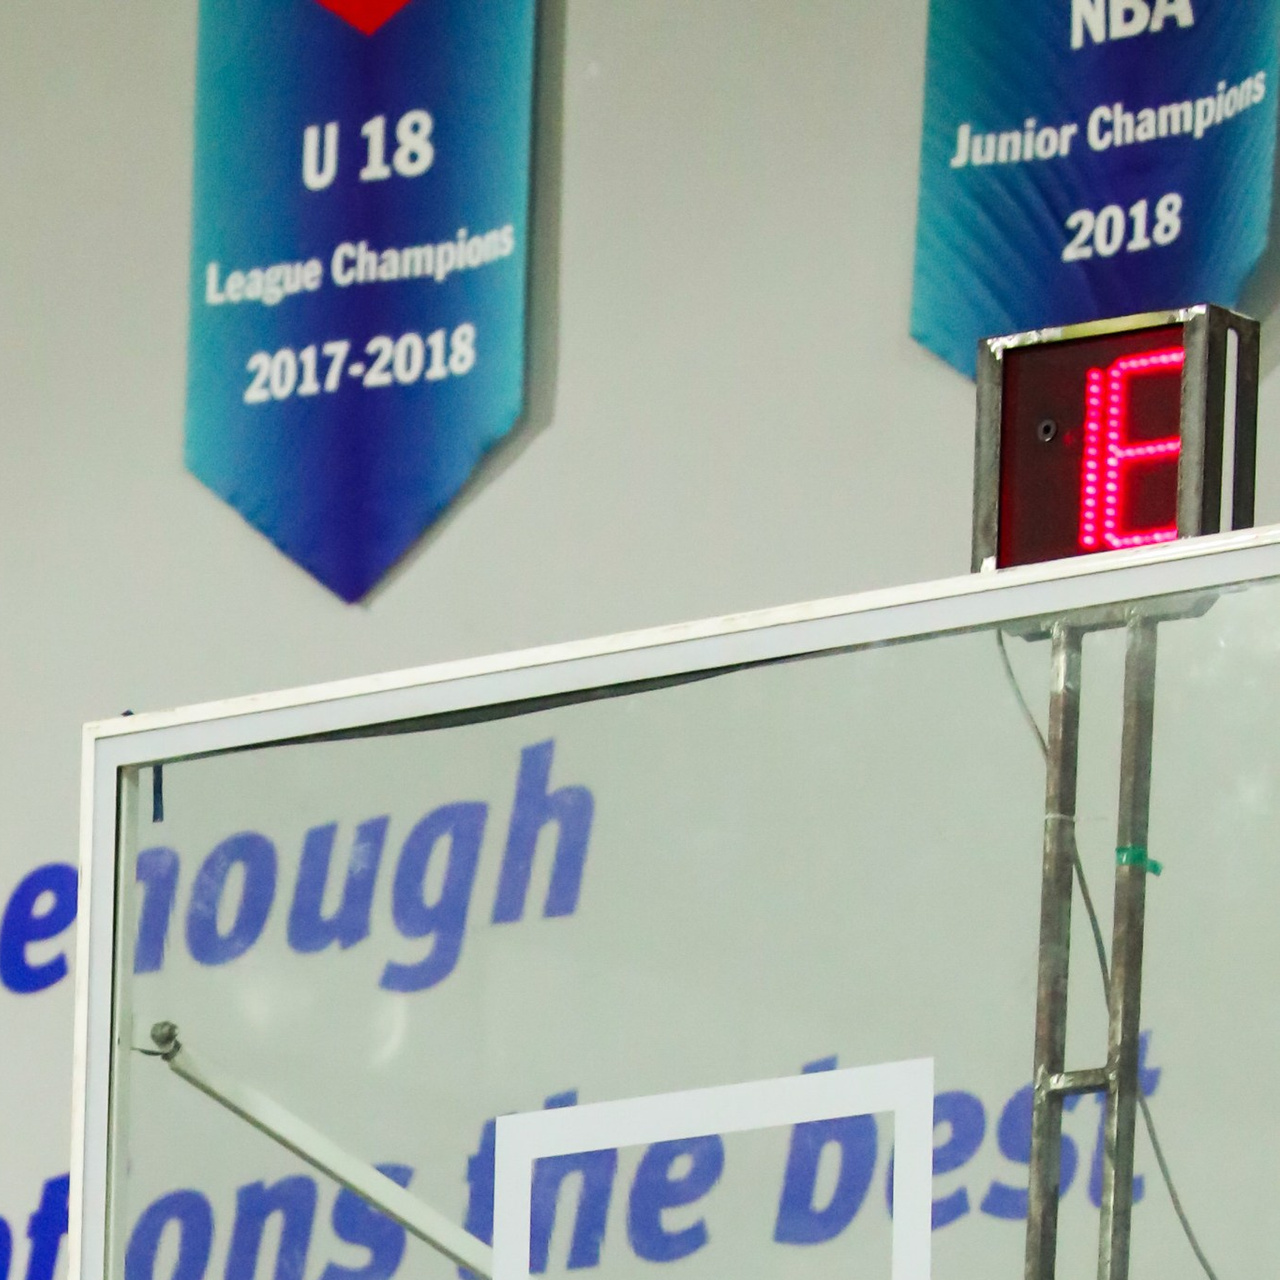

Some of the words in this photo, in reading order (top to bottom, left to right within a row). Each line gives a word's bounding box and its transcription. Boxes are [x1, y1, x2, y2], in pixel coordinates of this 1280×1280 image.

[302, 121, 339, 191] U
[359, 109, 435, 182] 18
[950, 118, 1078, 169] Junior
[1086, 70, 1267, 152] Champions
[205, 258, 323, 306] League
[331, 222, 516, 287] Champions
[1061, 192, 1184, 263] 2018
[242, 321, 477, 405] 2017-2018
